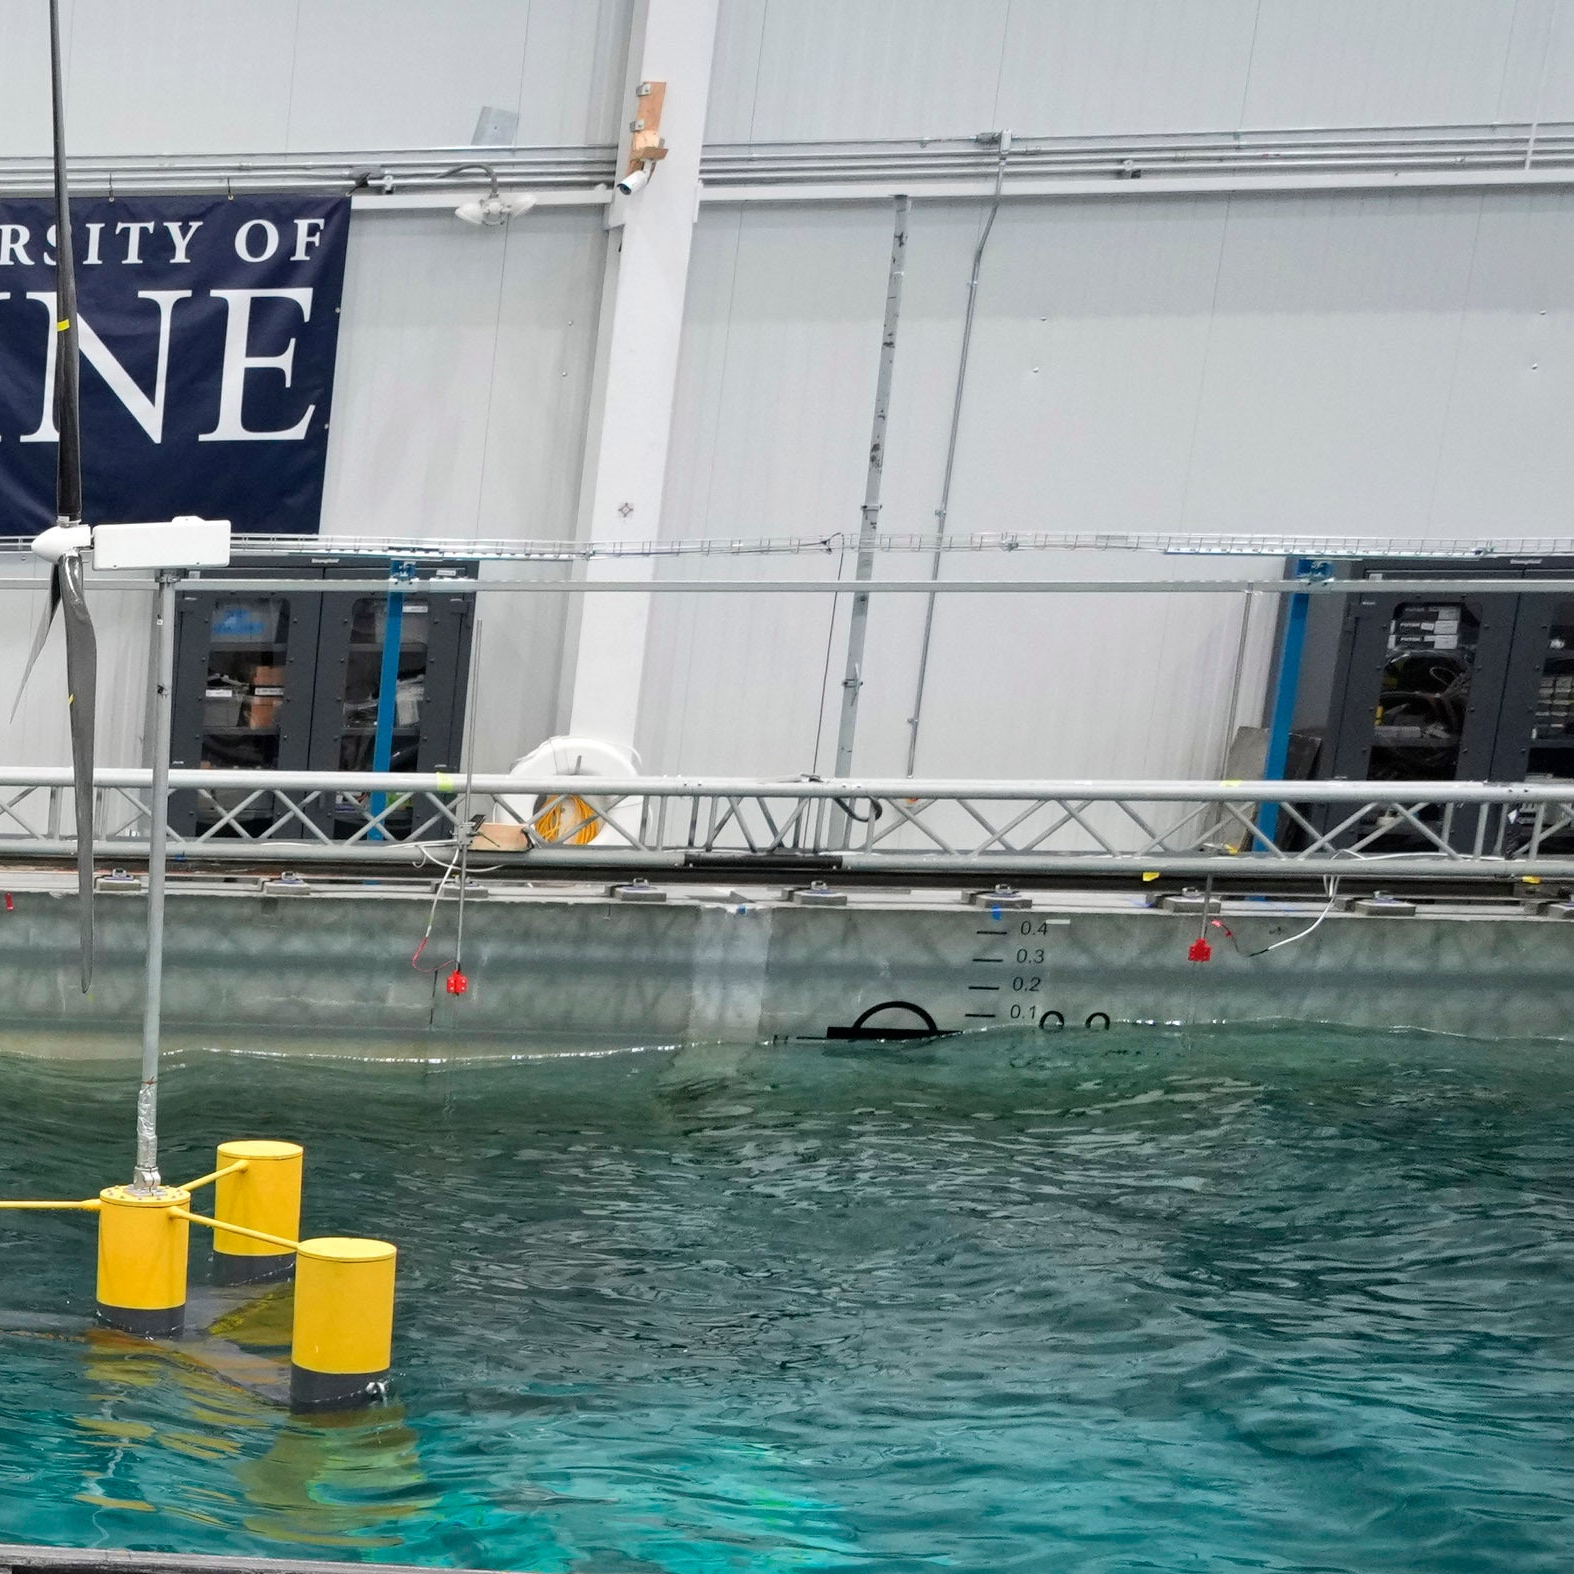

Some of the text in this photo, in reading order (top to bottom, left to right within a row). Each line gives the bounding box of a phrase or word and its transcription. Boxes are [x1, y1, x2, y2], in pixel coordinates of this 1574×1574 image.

[234, 218, 325, 264] OF
[1020, 920, 1048, 936] 0.4
[1016, 948, 1045, 964] 0.3
[1012, 976, 1041, 992] 0.2
[1010, 1004, 1036, 1020] 0.1
